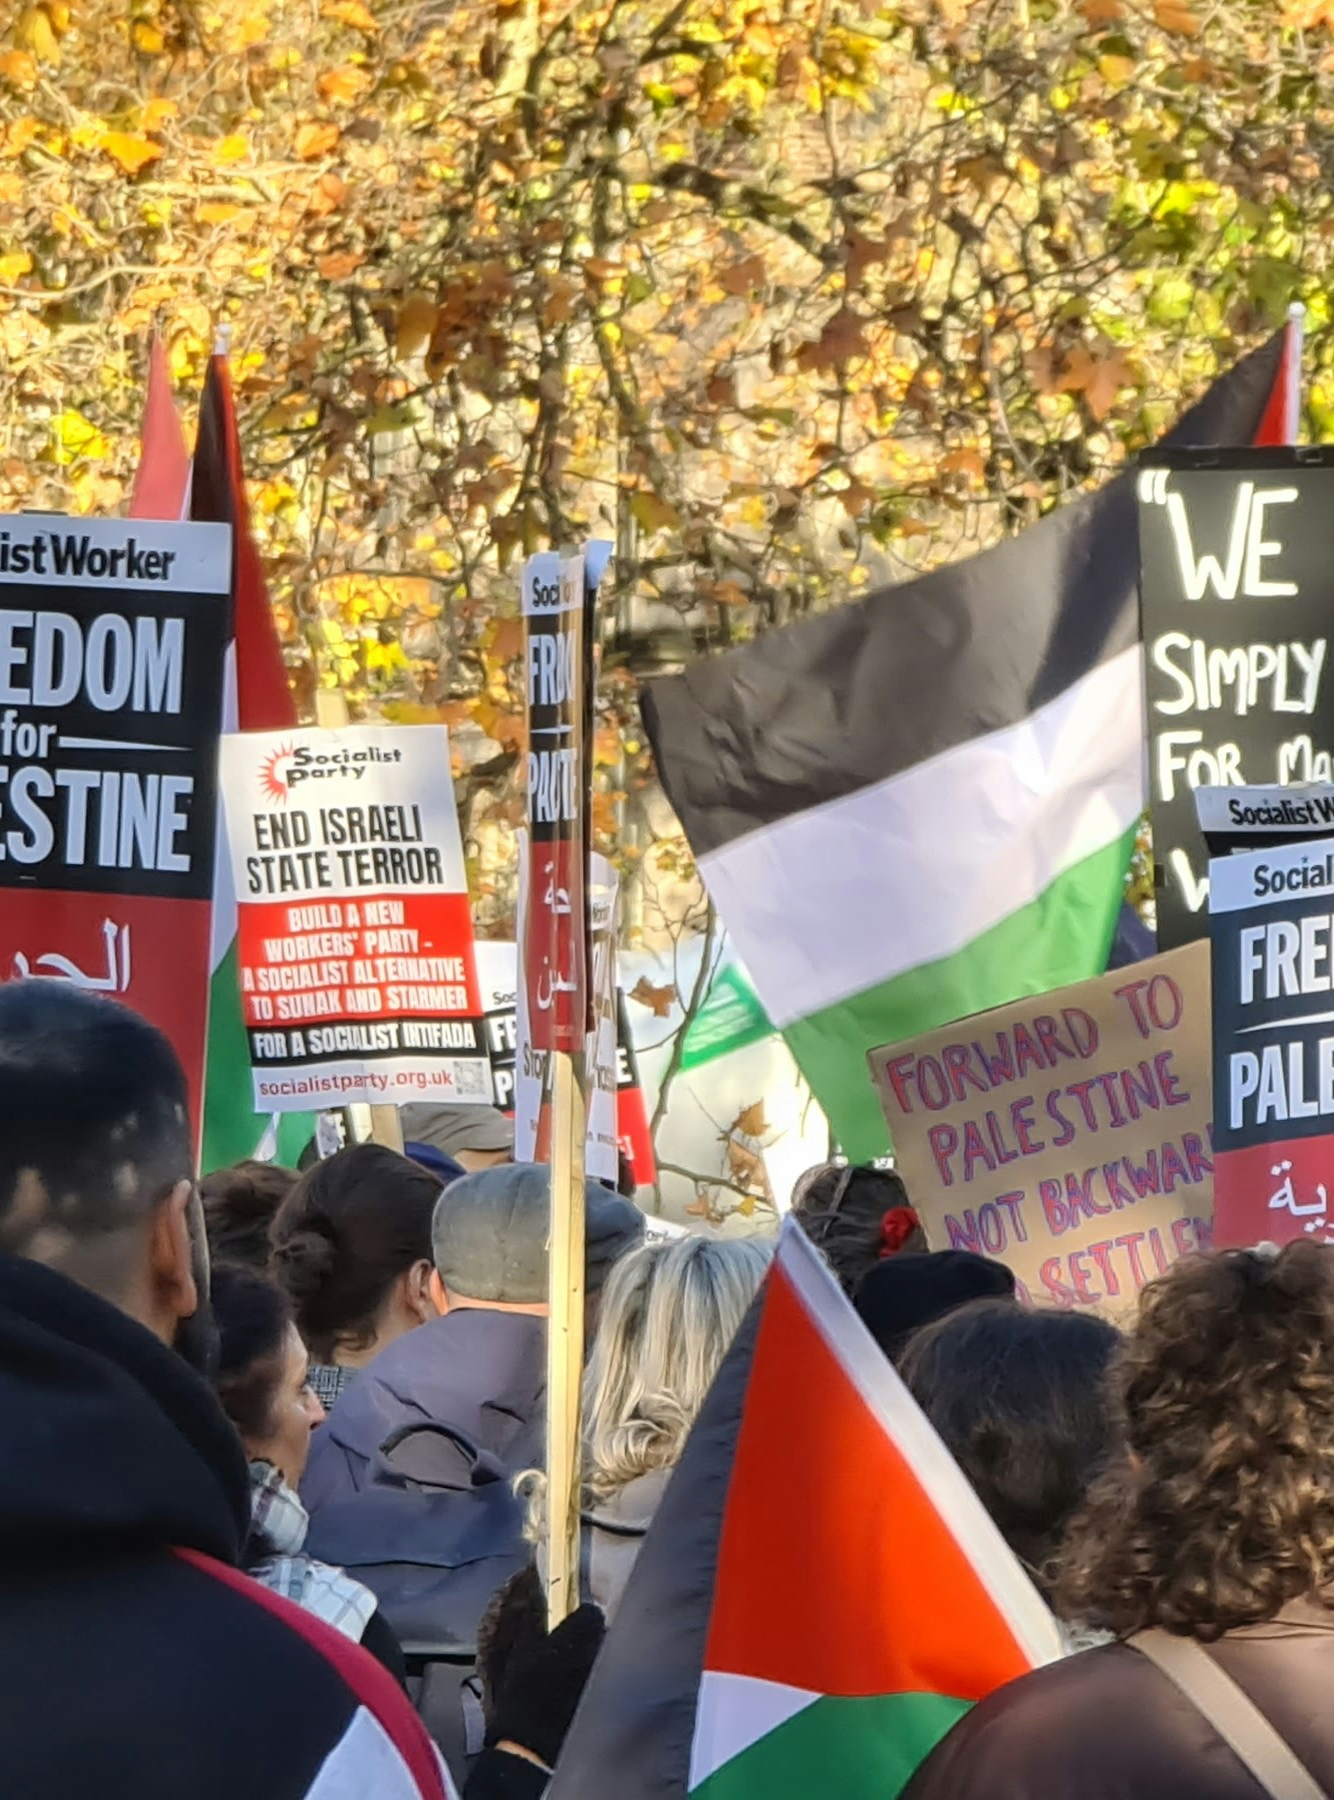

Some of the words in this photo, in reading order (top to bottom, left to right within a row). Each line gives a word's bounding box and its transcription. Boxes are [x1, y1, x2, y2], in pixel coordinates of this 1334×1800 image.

[49, 535, 176, 580] Worker
[1152, 631, 1327, 715] SIMPLY
[0, 710, 57, 758] for
[294, 747, 402, 766] Socialist
[1157, 730, 1246, 801] FOR
[253, 811, 311, 851] END
[320, 804, 423, 845] ISRAELI
[1228, 797, 1318, 826] Socialist
[247, 851, 332, 894] STATE
[338, 847, 444, 887] TERROR
[288, 904, 343, 932] BUILD
[347, 903, 360, 927] A
[365, 901, 404, 925] NEW
[264, 934, 359, 963] WORKERS'
[365, 930, 419, 954] PARTY
[243, 967, 255, 992] A
[259, 961, 348, 991] SOCIALIST
[354, 958, 465, 984] ALTERNATIVE
[251, 996, 273, 1020] TO
[277, 989, 341, 1019] SUNAK
[345, 987, 381, 1013] AND
[387, 986, 467, 1011] STARMER
[253, 1033, 287, 1059] FOR
[292, 1032, 306, 1057] A
[308, 1024, 399, 1053] SOCIALIST
[403, 1022, 476, 1049] INTIFADA
[886, 1008, 1099, 1114] FORWARD
[1113, 974, 1183, 1039] TO
[260, 1070, 452, 1095] socialistparty.org.uk
[927, 1050, 1191, 1187] PALESTINE
[944, 1190, 1028, 1255] NOT
[1040, 1122, 1214, 1236] BACKWAR
